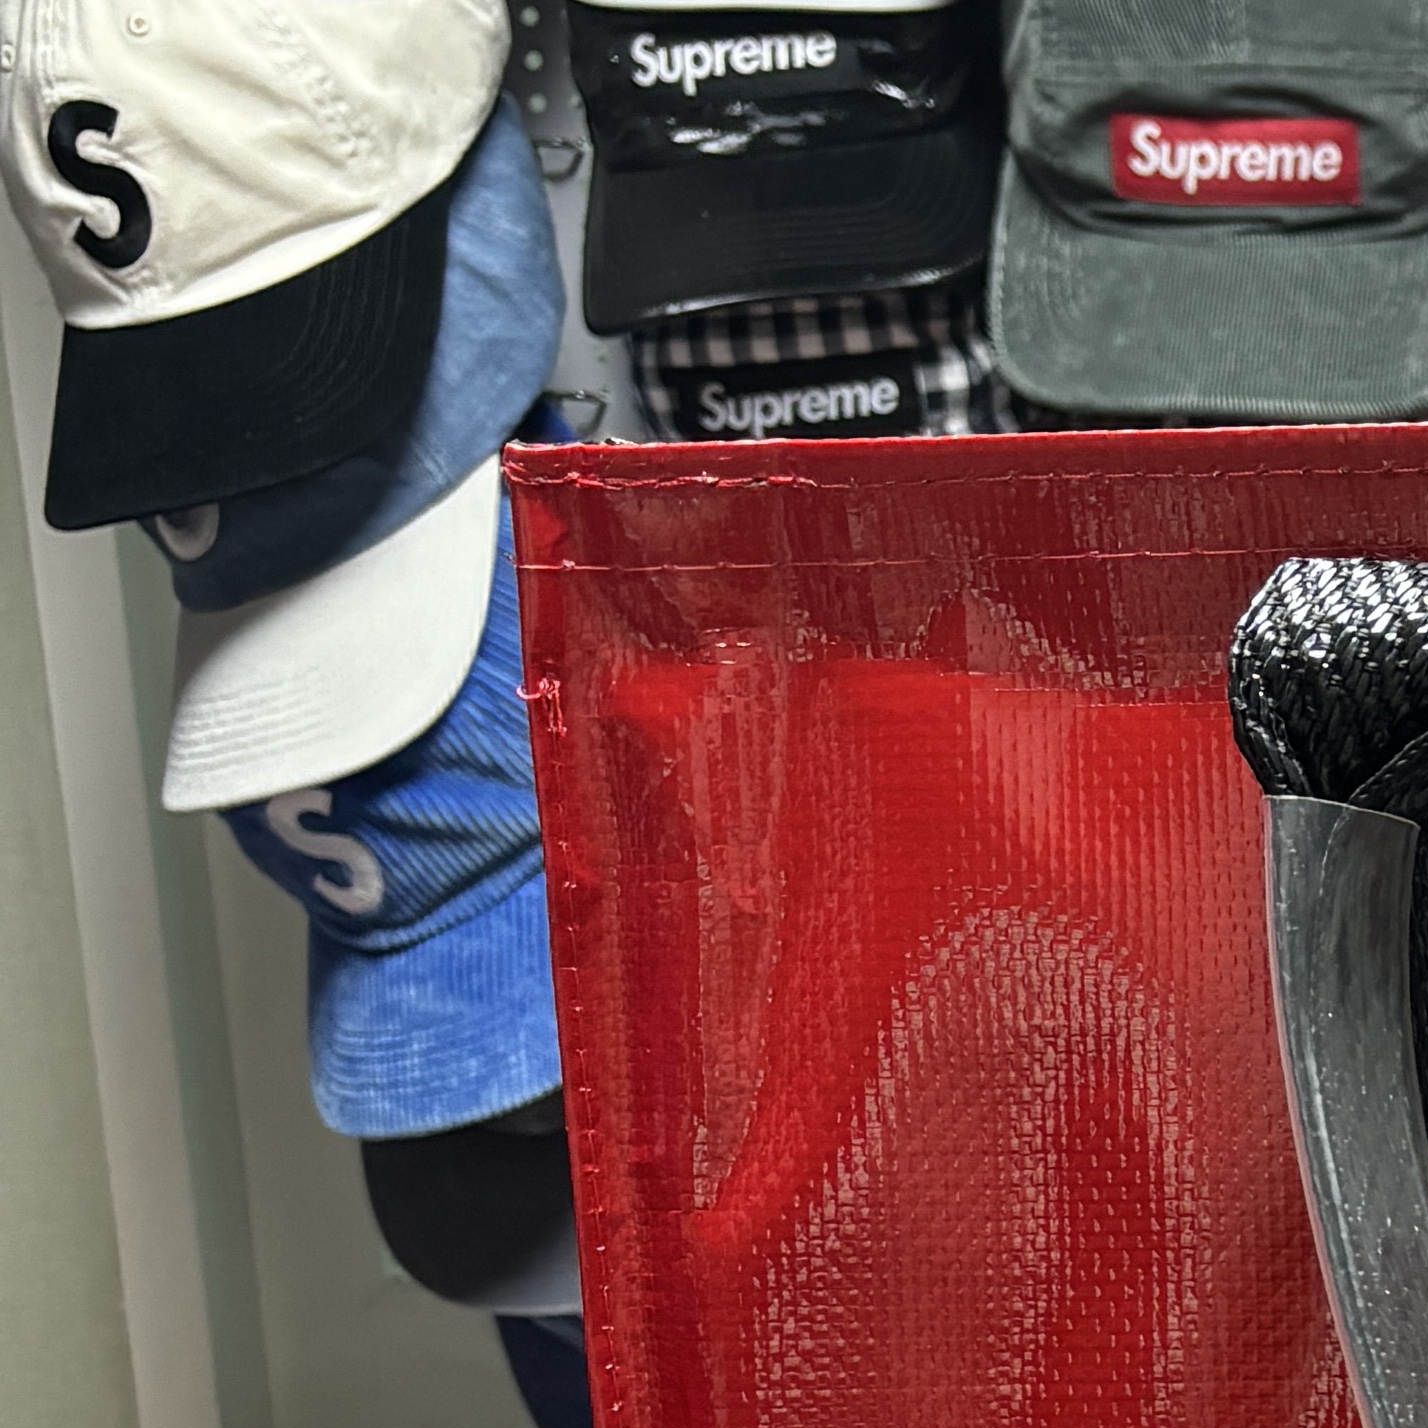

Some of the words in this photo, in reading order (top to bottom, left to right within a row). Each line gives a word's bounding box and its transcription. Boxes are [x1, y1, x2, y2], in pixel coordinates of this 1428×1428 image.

[630, 31, 837, 96] Supreme
[47, 98, 152, 270] S
[1127, 118, 1343, 195] Supreme
[699, 377, 900, 438] Supreme
[266, 788, 384, 915] S
